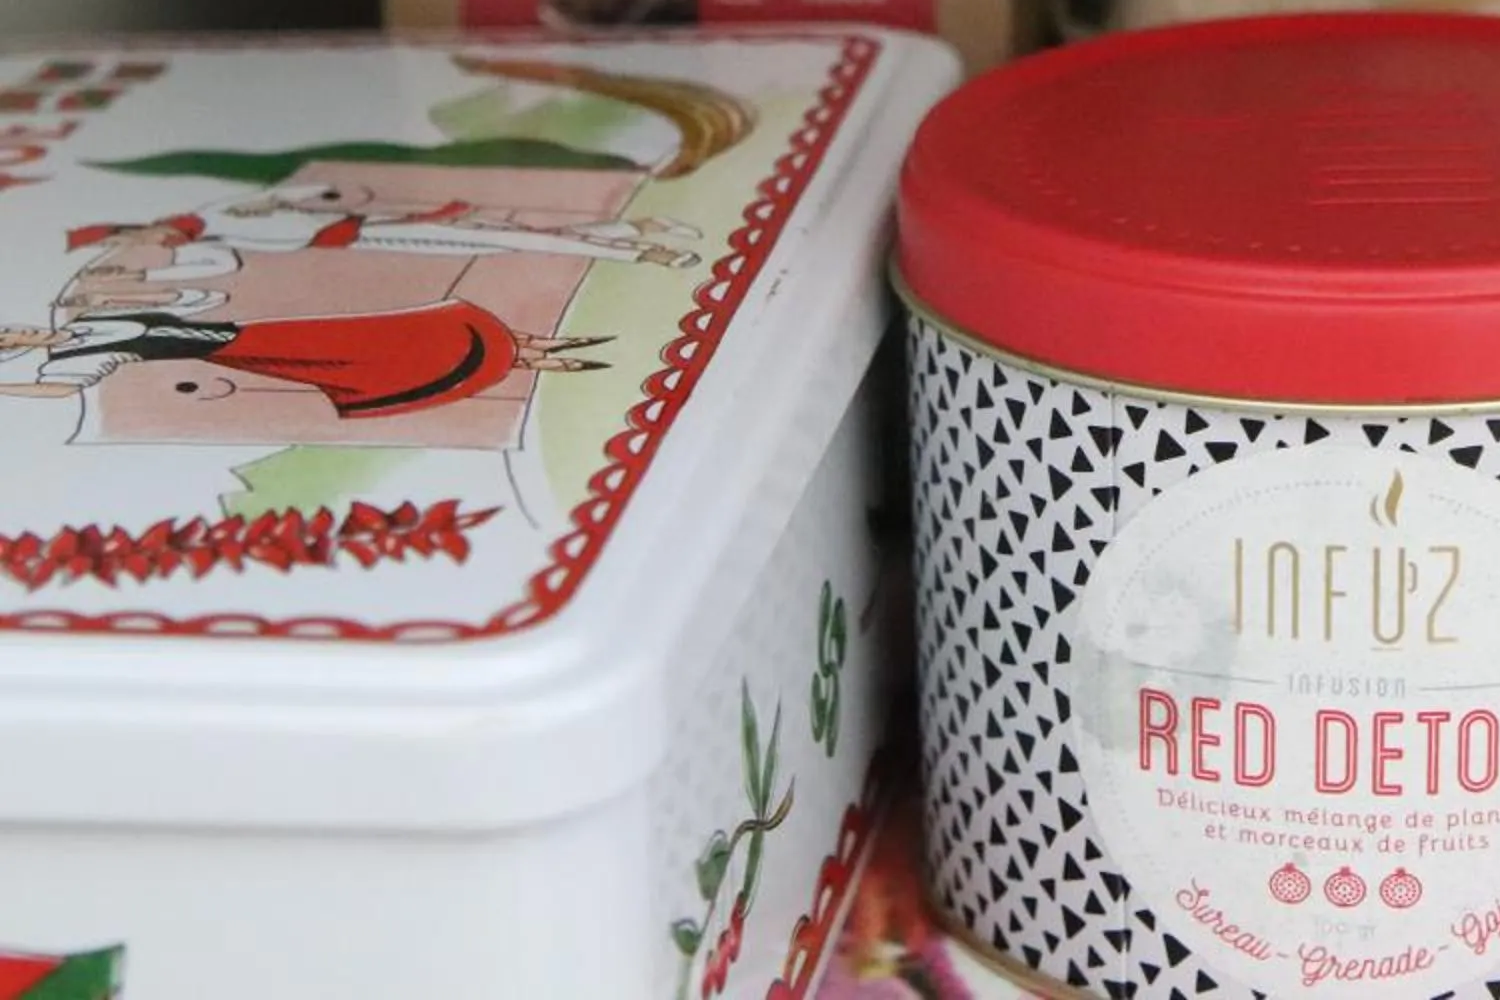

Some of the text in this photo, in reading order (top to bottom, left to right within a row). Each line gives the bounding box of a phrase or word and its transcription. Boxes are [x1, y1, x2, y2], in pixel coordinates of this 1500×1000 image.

[1288, 674, 1406, 697] INFUSION
[1139, 688, 1275, 787] RED
[1157, 788, 1272, 822] Délicieux
[1284, 808, 1394, 834] mélange
[1405, 808, 1435, 829] de
[1204, 824, 1491, 857] et morceaux de fruits
[1174, 877, 1273, 961] Sureau
[1297, 942, 1435, 988] Grenade
